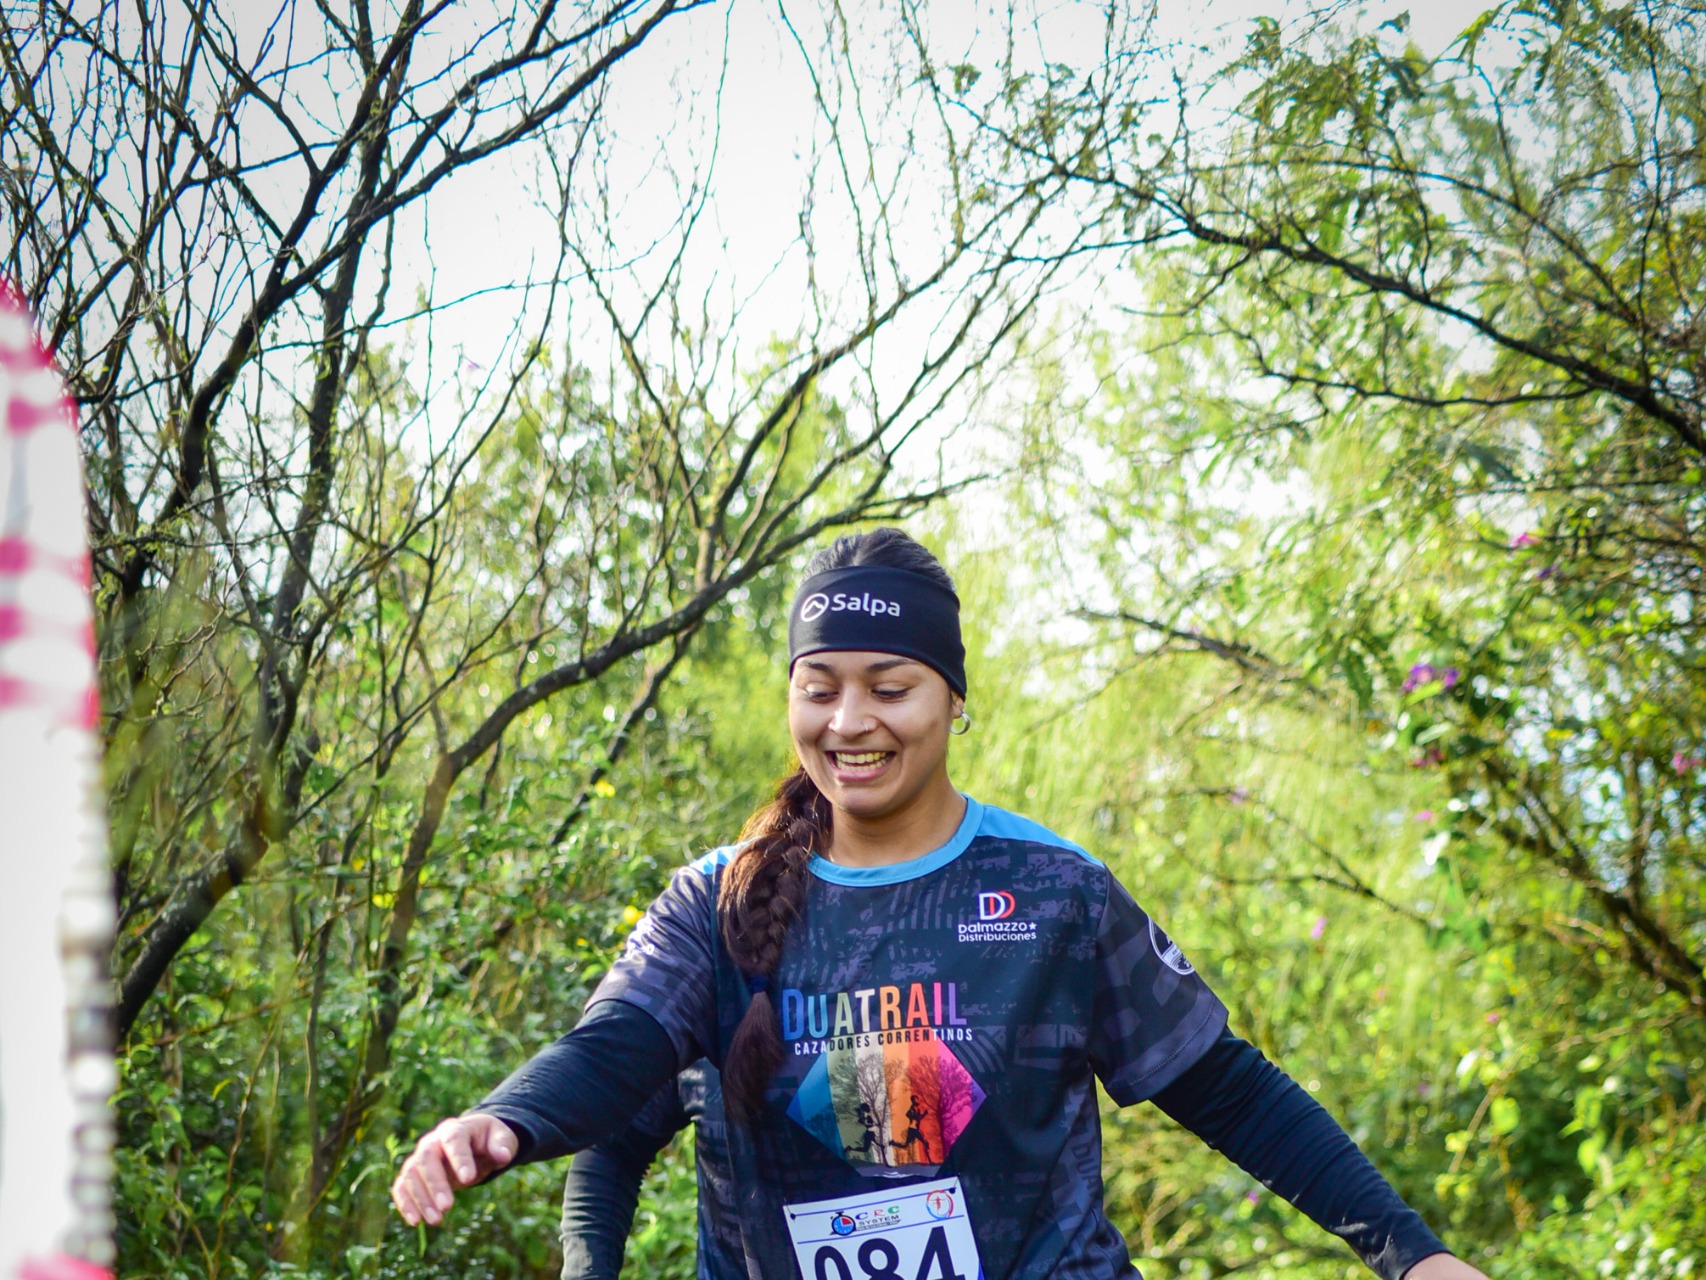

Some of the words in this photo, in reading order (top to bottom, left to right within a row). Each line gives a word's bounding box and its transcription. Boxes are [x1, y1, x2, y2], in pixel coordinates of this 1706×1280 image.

[831, 592, 900, 617] Salpa
[958, 922, 1028, 934] Dalmazzo
[958, 931, 1037, 943] Distribuciones
[782, 981, 967, 1041] DUATRAIL
[794, 1034, 870, 1056] CAZADORES
[877, 1028, 973, 1045] CORRENTINOS
